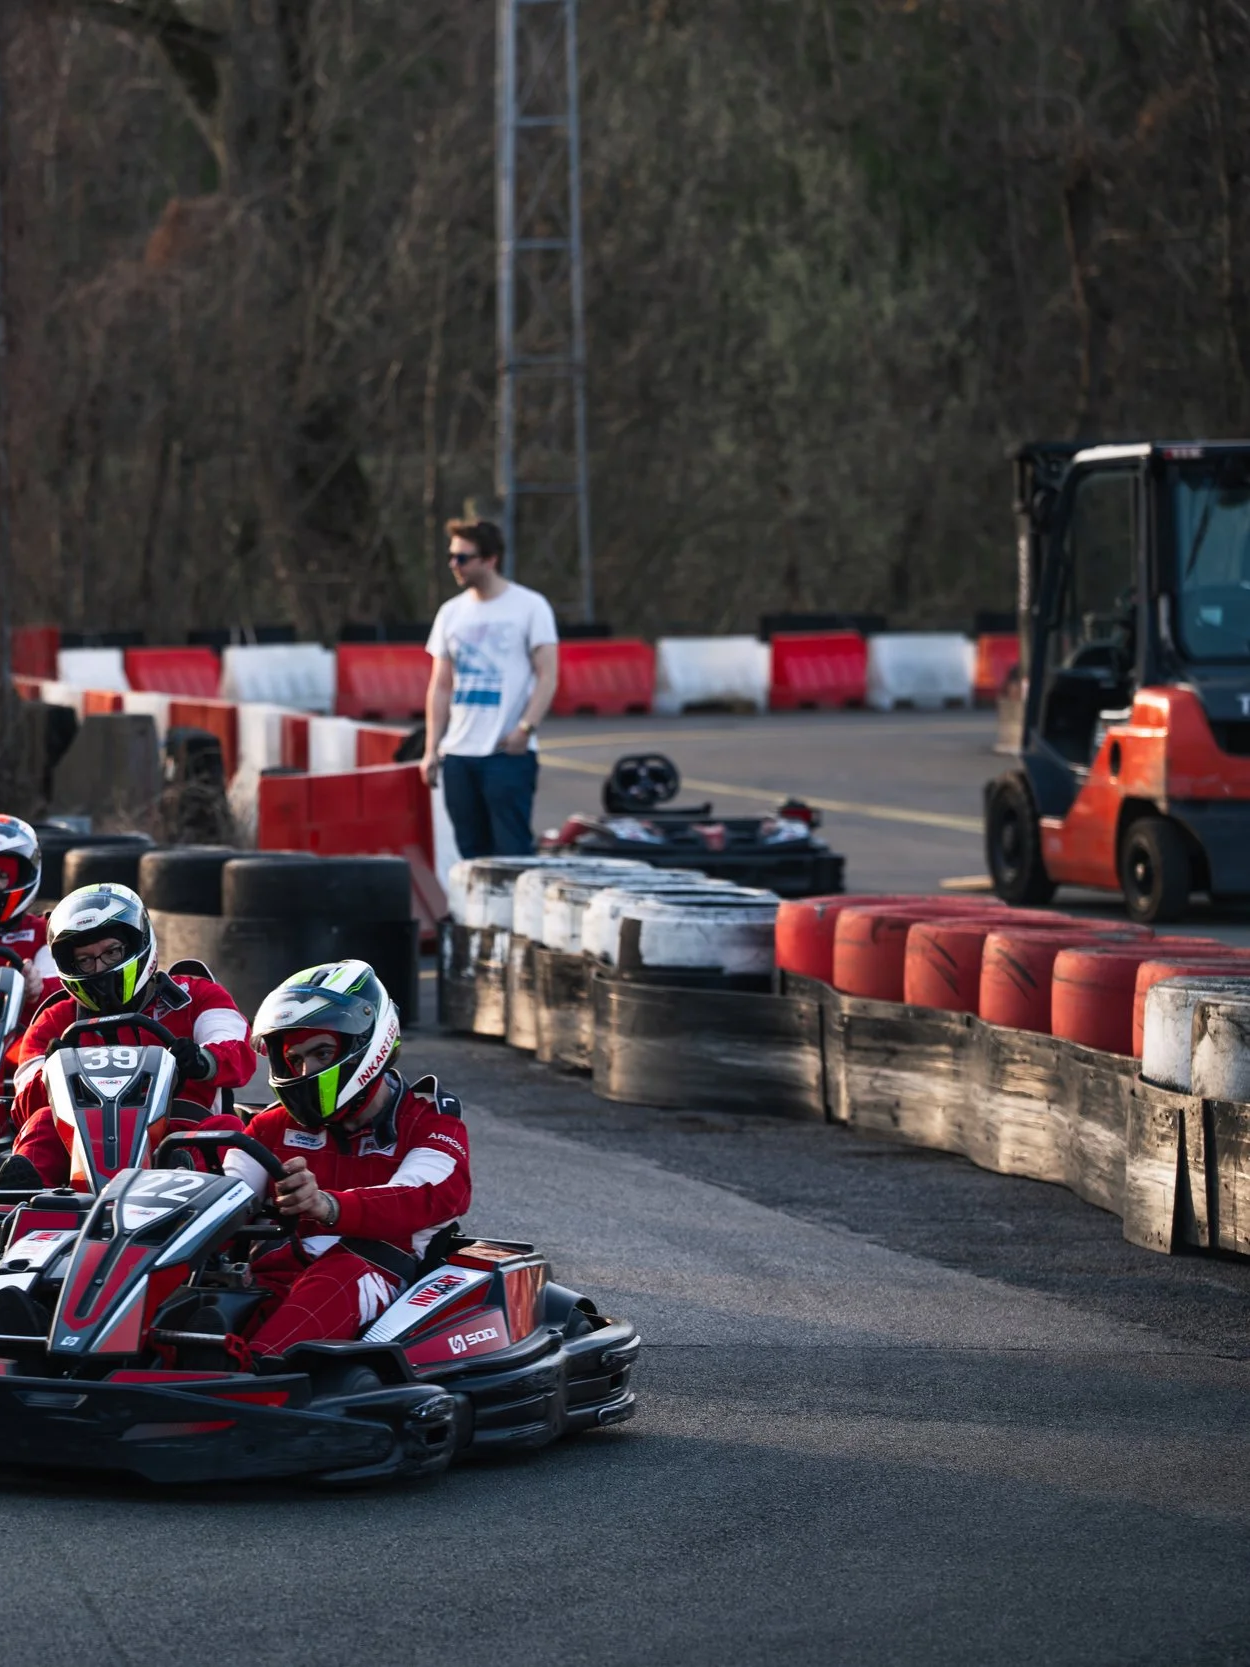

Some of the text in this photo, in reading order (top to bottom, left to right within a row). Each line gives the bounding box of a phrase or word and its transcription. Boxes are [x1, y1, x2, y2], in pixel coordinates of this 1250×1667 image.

[83, 1047, 138, 1070] 39
[126, 1173, 205, 1202] 22
[465, 1327, 499, 1345] SODI
